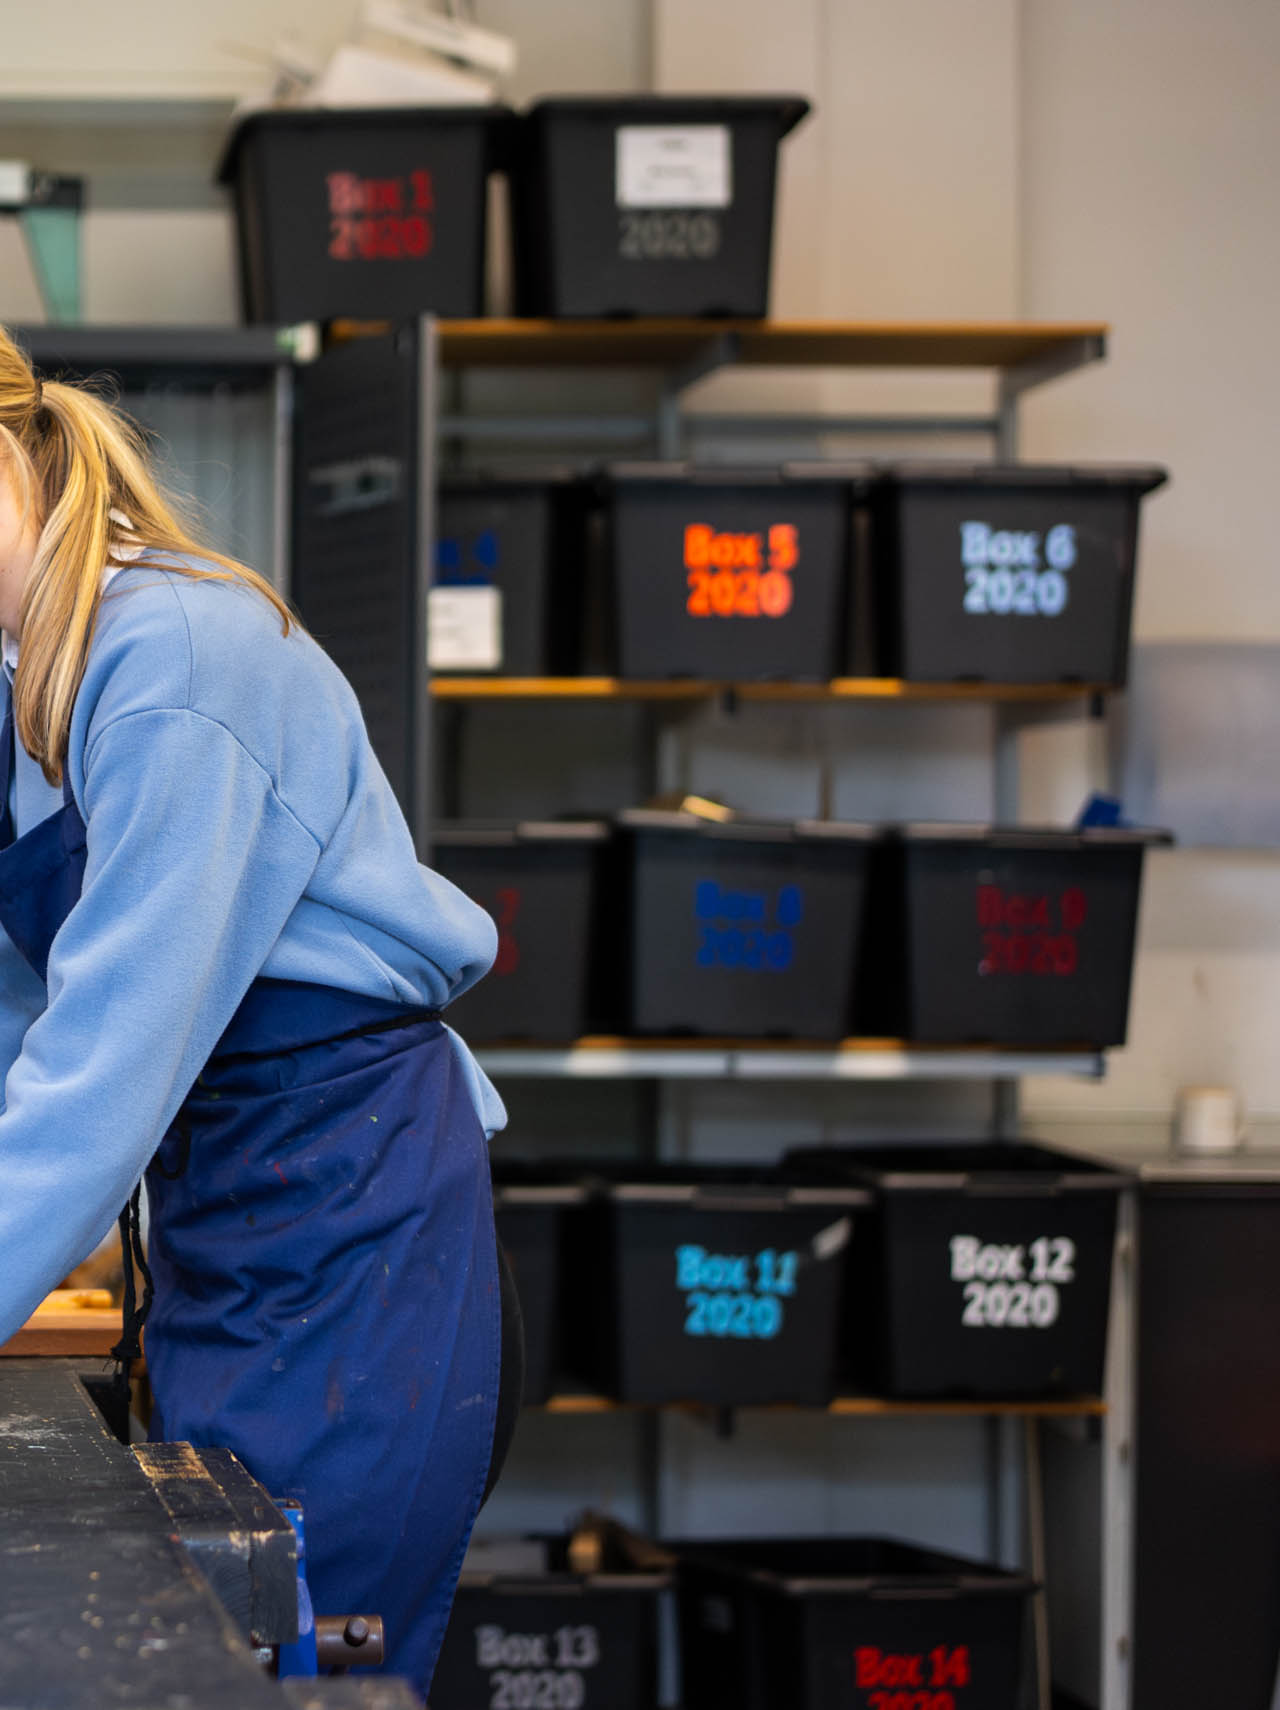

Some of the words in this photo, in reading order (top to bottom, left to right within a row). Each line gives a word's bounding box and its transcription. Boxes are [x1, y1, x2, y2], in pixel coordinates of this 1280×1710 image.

[327, 172, 401, 212] Box
[410, 170, 433, 212] 1
[328, 217, 431, 259] 2020
[619, 215, 719, 258] 2020
[684, 524, 762, 568] Box
[768, 524, 798, 569] 5
[961, 522, 1039, 567] Box
[1046, 524, 1076, 567] 6
[687, 571, 792, 616] 2020
[964, 570, 1067, 615] 2020
[694, 880, 766, 922] Box
[696, 928, 794, 972] 2020
[979, 932, 1077, 976] 2020
[677, 1245, 748, 1290] Box
[754, 1250, 797, 1295] 11
[951, 1236, 1023, 1283] Box
[1029, 1237, 1074, 1283] 12
[686, 1293, 782, 1338] 2020
[963, 1284, 1058, 1327] 2020
[476, 1625, 548, 1667] Box
[555, 1625, 599, 1668] 13
[854, 1646, 923, 1688] Box
[929, 1645, 970, 1687] 14
[490, 1669, 584, 1710] 2020
